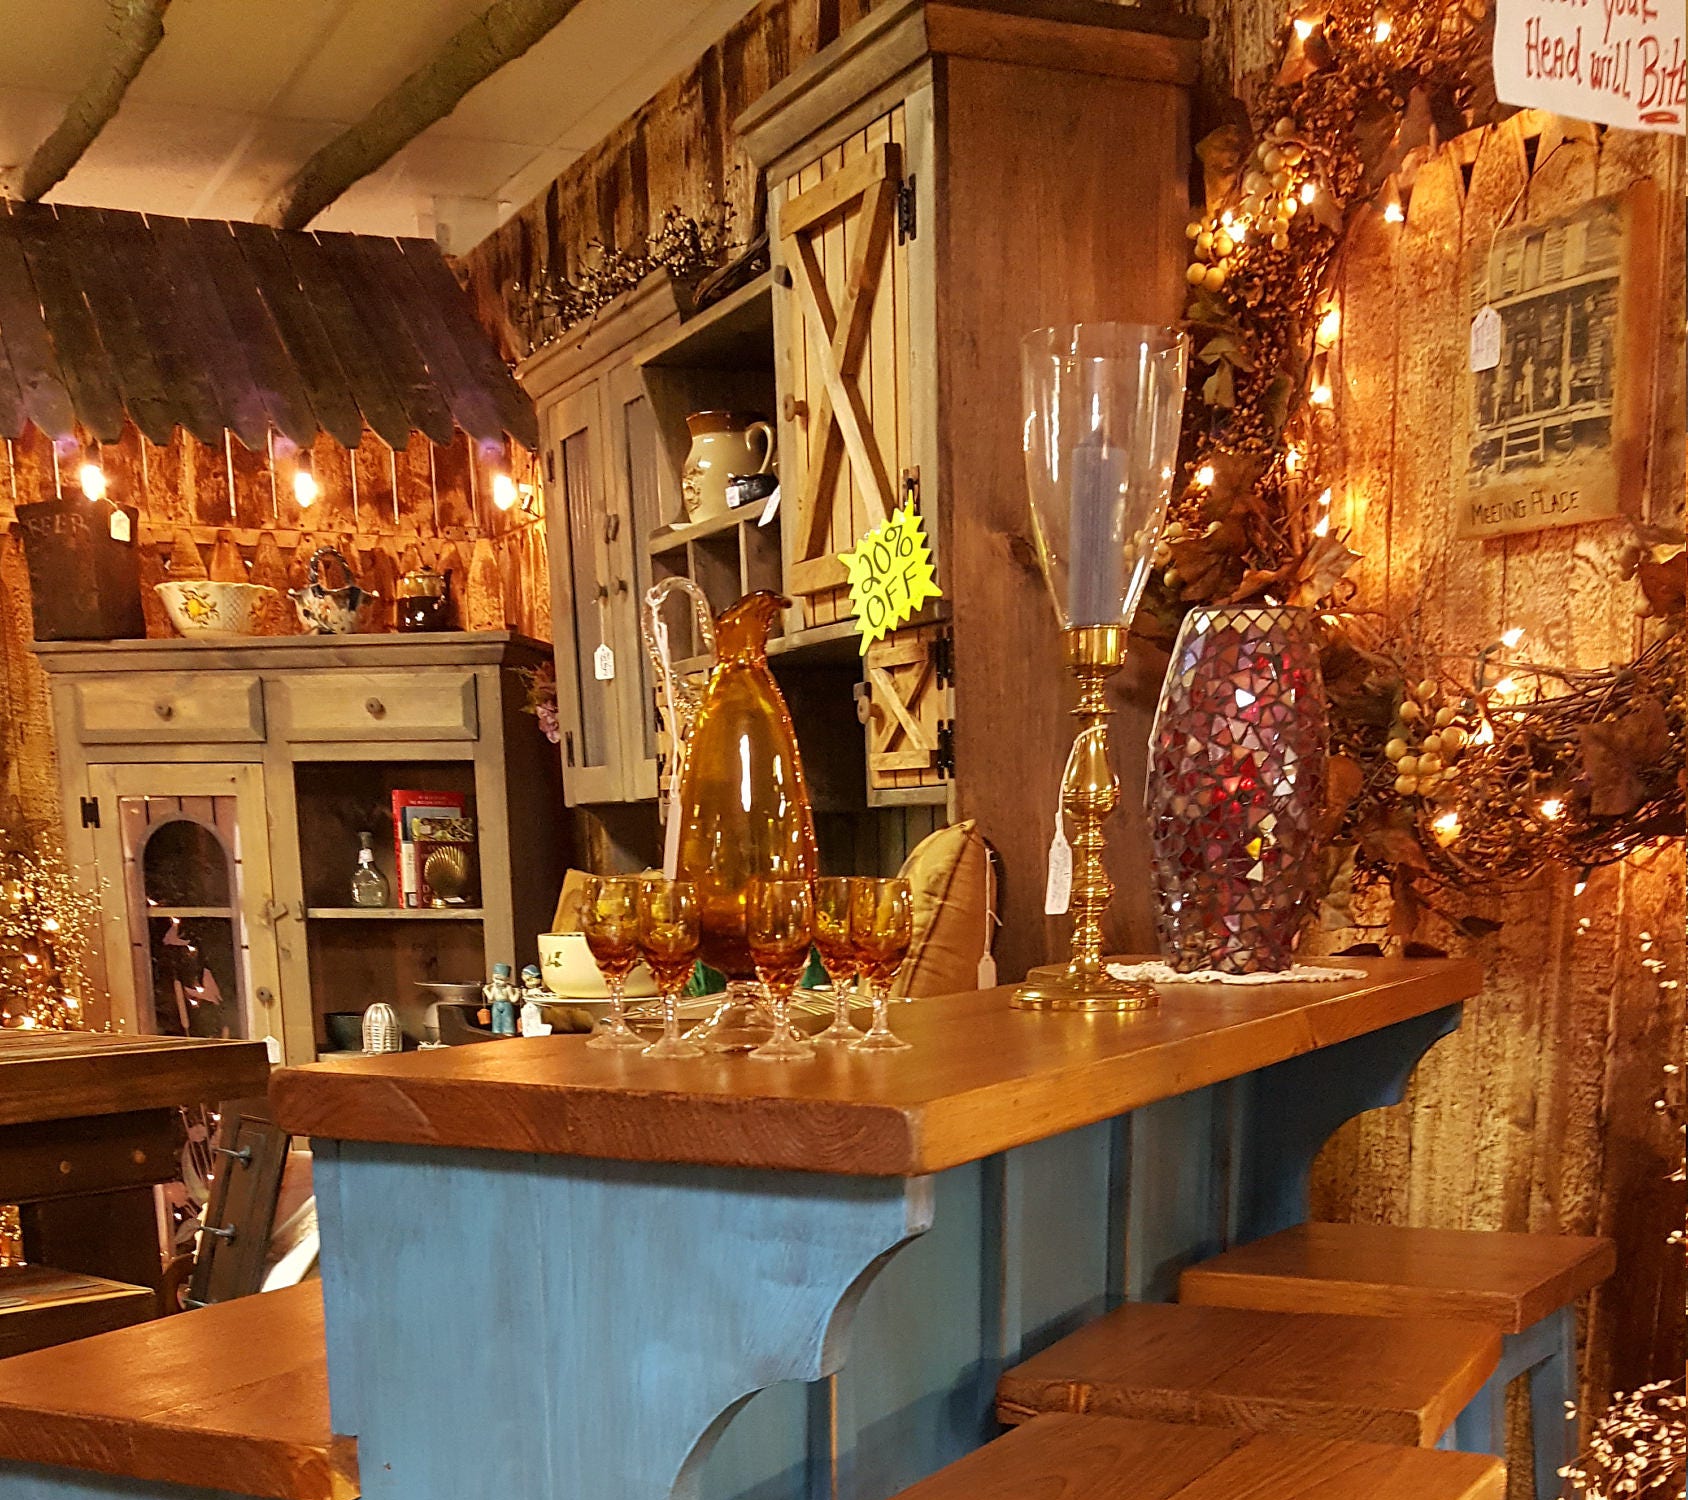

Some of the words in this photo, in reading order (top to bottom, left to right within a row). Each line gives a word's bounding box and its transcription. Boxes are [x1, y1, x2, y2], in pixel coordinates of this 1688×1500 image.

[1590, 38, 1631, 98] will
[1471, 499, 1527, 525] MEETING
[1530, 490, 1580, 514] PLACE
[858, 524, 914, 594] 20%
[866, 560, 917, 628] OFF
